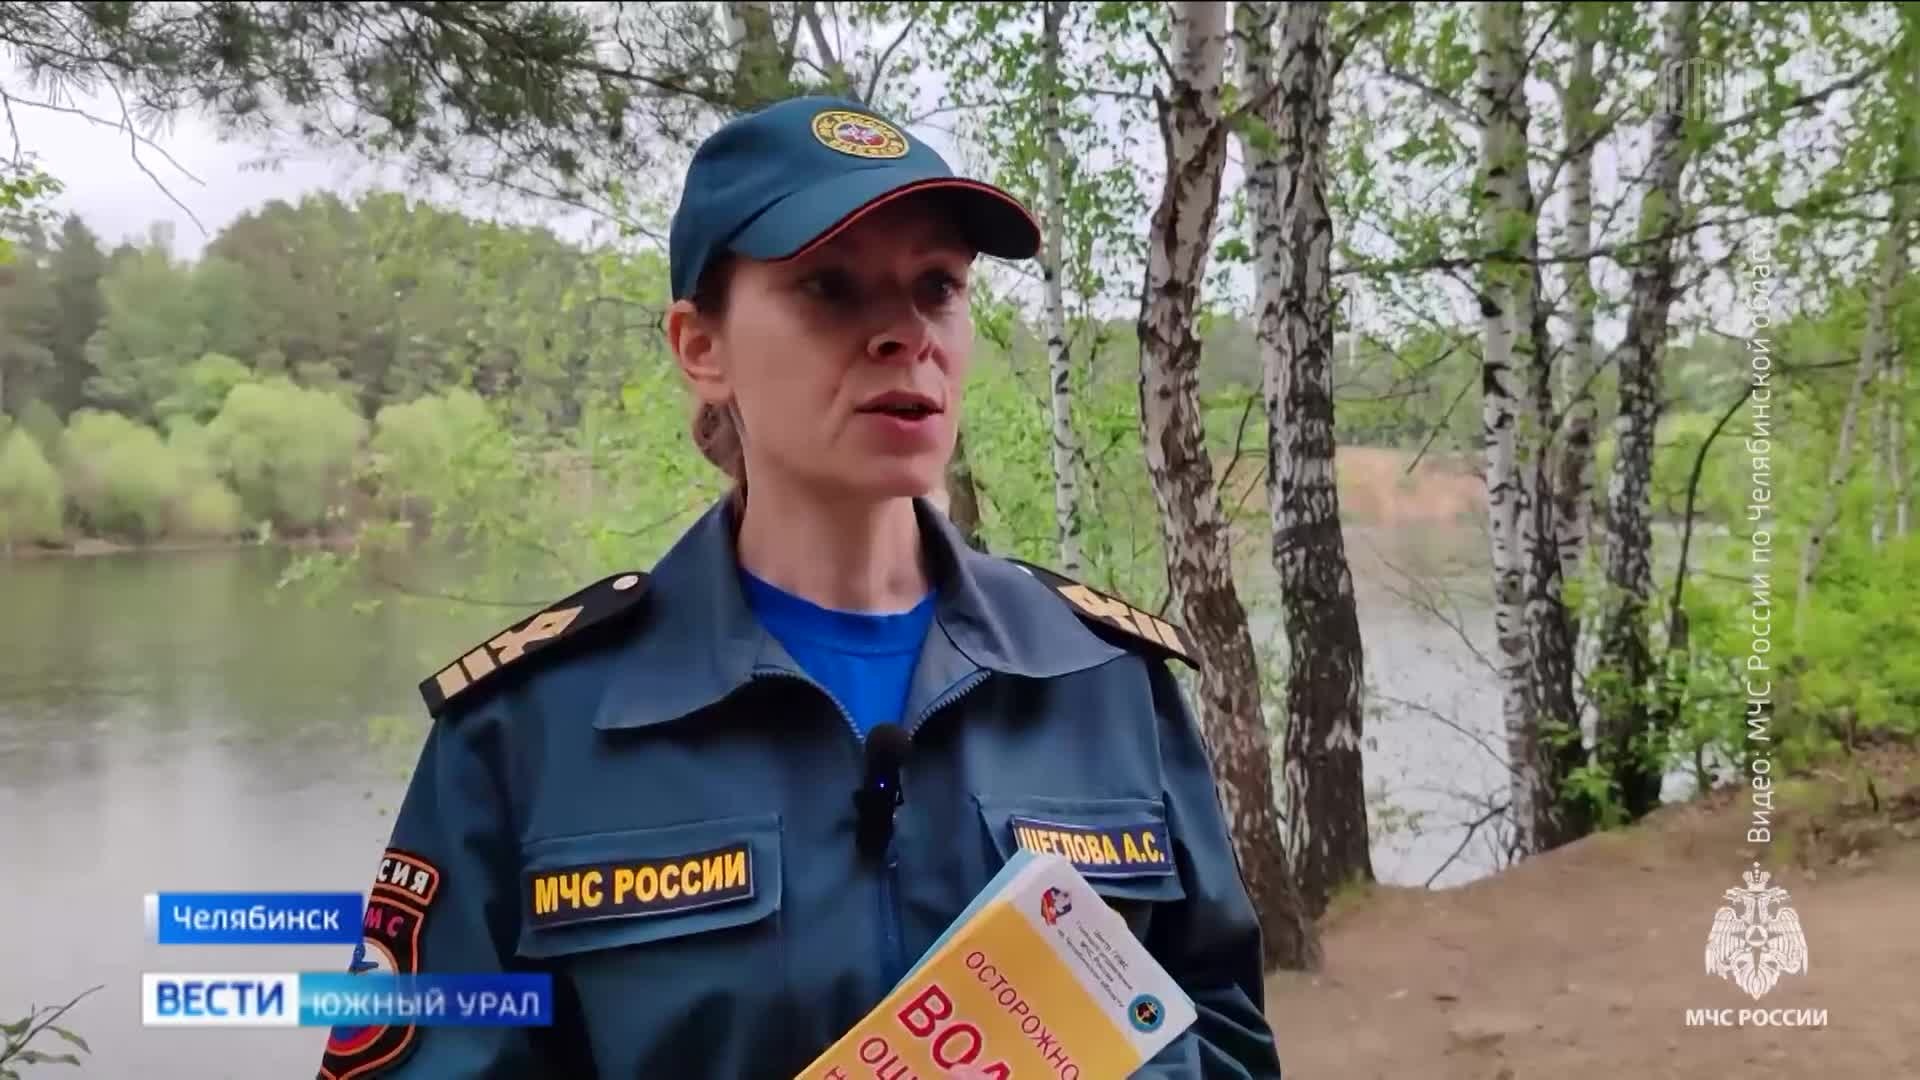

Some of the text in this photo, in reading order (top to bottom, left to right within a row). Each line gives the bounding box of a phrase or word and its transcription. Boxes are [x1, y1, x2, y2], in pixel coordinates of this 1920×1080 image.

[1123, 831, 1165, 863] А.С.
[534, 851, 746, 915] МЧС РОССИИ
[966, 951, 1080, 1080] ОСТОРОЖНО
